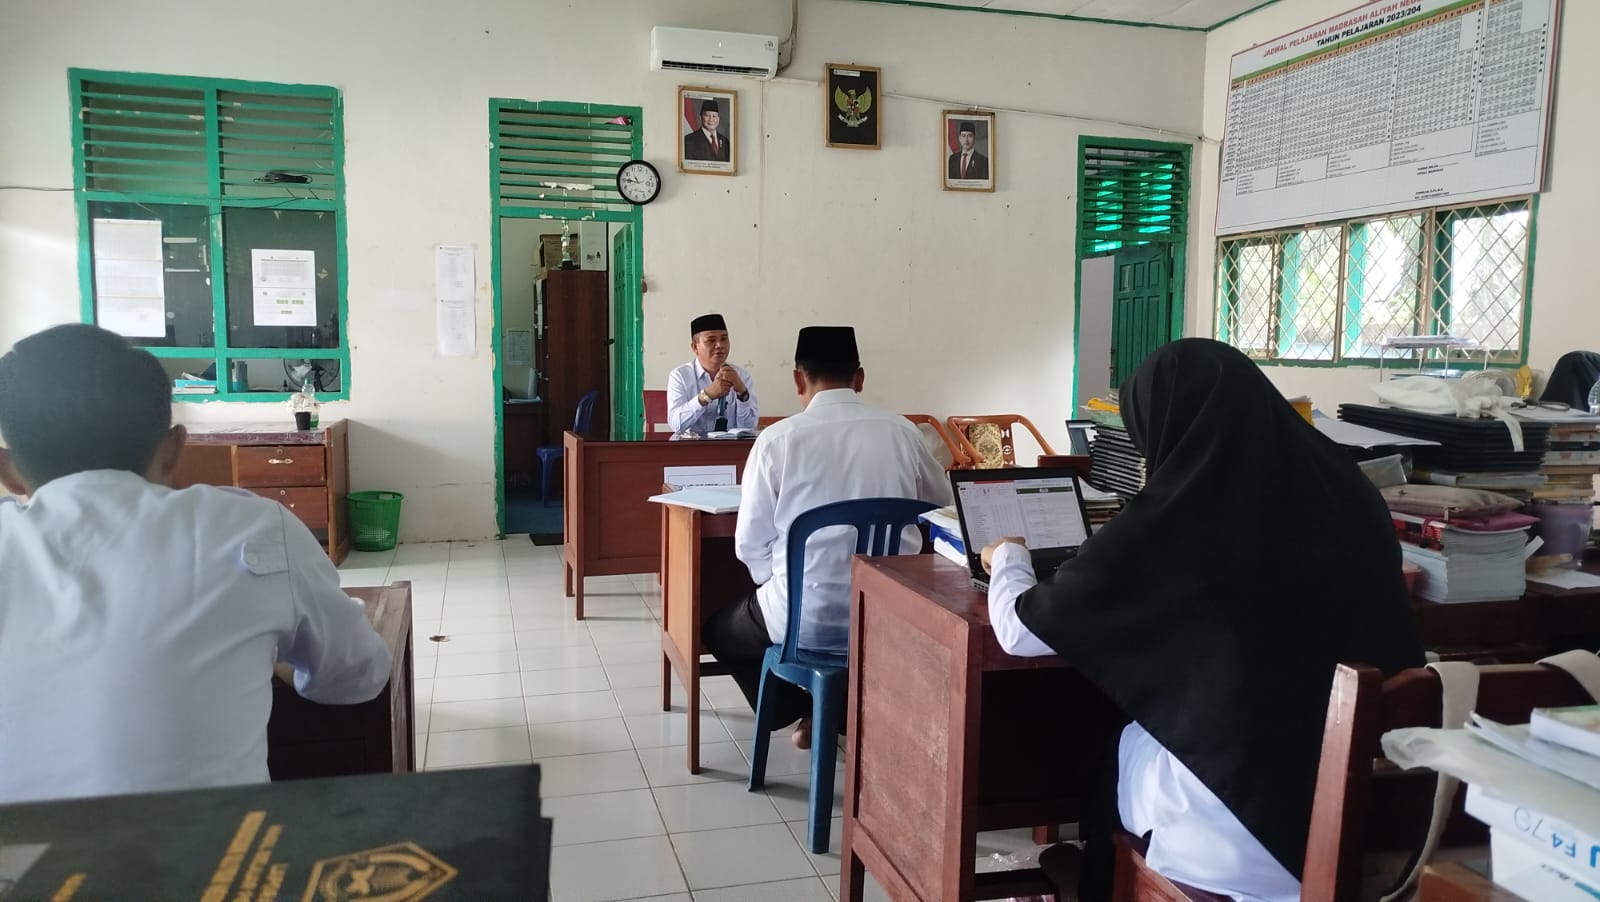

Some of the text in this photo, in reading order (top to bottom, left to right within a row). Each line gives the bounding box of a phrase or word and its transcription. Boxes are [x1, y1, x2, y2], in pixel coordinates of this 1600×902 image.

[1264, 43, 1288, 57] JADWAL
[1289, 29, 1327, 49] PELAJARAN
[1329, 14, 1368, 33] MADRASAH
[1370, 2, 1398, 18] ALIYAH
[1317, 33, 1340, 47] TAHUN
[1342, 18, 1385, 38] PELAJARAN
